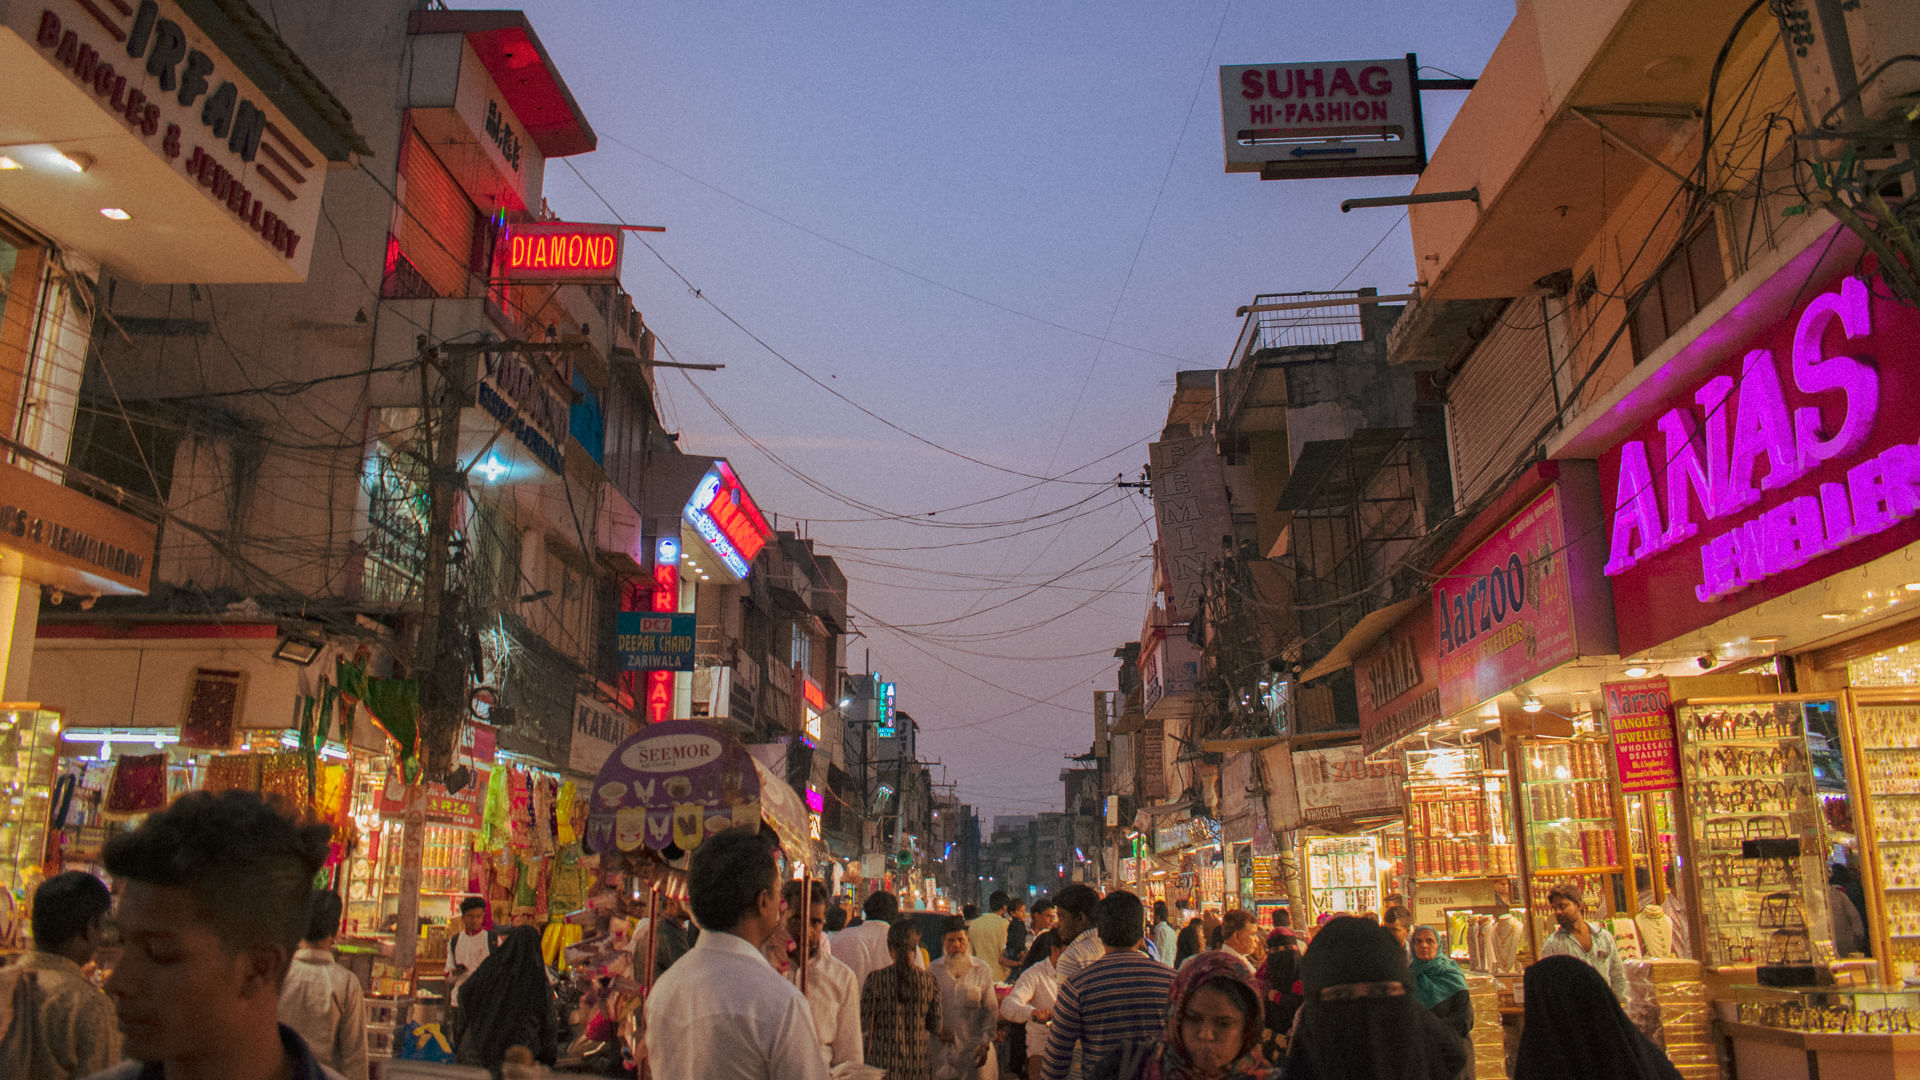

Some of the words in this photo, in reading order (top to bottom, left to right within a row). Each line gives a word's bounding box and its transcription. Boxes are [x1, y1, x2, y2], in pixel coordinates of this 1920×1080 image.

[1241, 65, 1393, 99] SUHAG
[36, 9, 161, 136] BANGLES
[163, 122, 181, 158] &
[186, 146, 301, 259] JEWELLERY
[511, 234, 615, 268] DIAMOND
[1604, 275, 1880, 577] ANAS
[1159, 442, 1206, 609] FEMINA
[1694, 438, 1920, 603] JEWELLER
[1439, 551, 1525, 659] Aarzoo
[642, 619, 671, 632] DCZ
[618, 635, 656, 652] DEEPAK
[658, 634, 692, 652] CHAND
[1479, 617, 1525, 662] JEWELLERS
[627, 654, 682, 667] ZARIWALA
[1369, 634, 1422, 712] SHAMA
[1610, 690, 1669, 717] Aarzoo
[1613, 715, 1660, 731] BANGLES
[1662, 715, 1672, 726] &
[1615, 728, 1674, 744] JEWELLERS
[639, 743, 711, 763] SEEMOR
[1619, 742, 1673, 753] WHOLESALE
[1629, 750, 1669, 761] DEALERS
[1419, 896, 1454, 905] SHAMA
